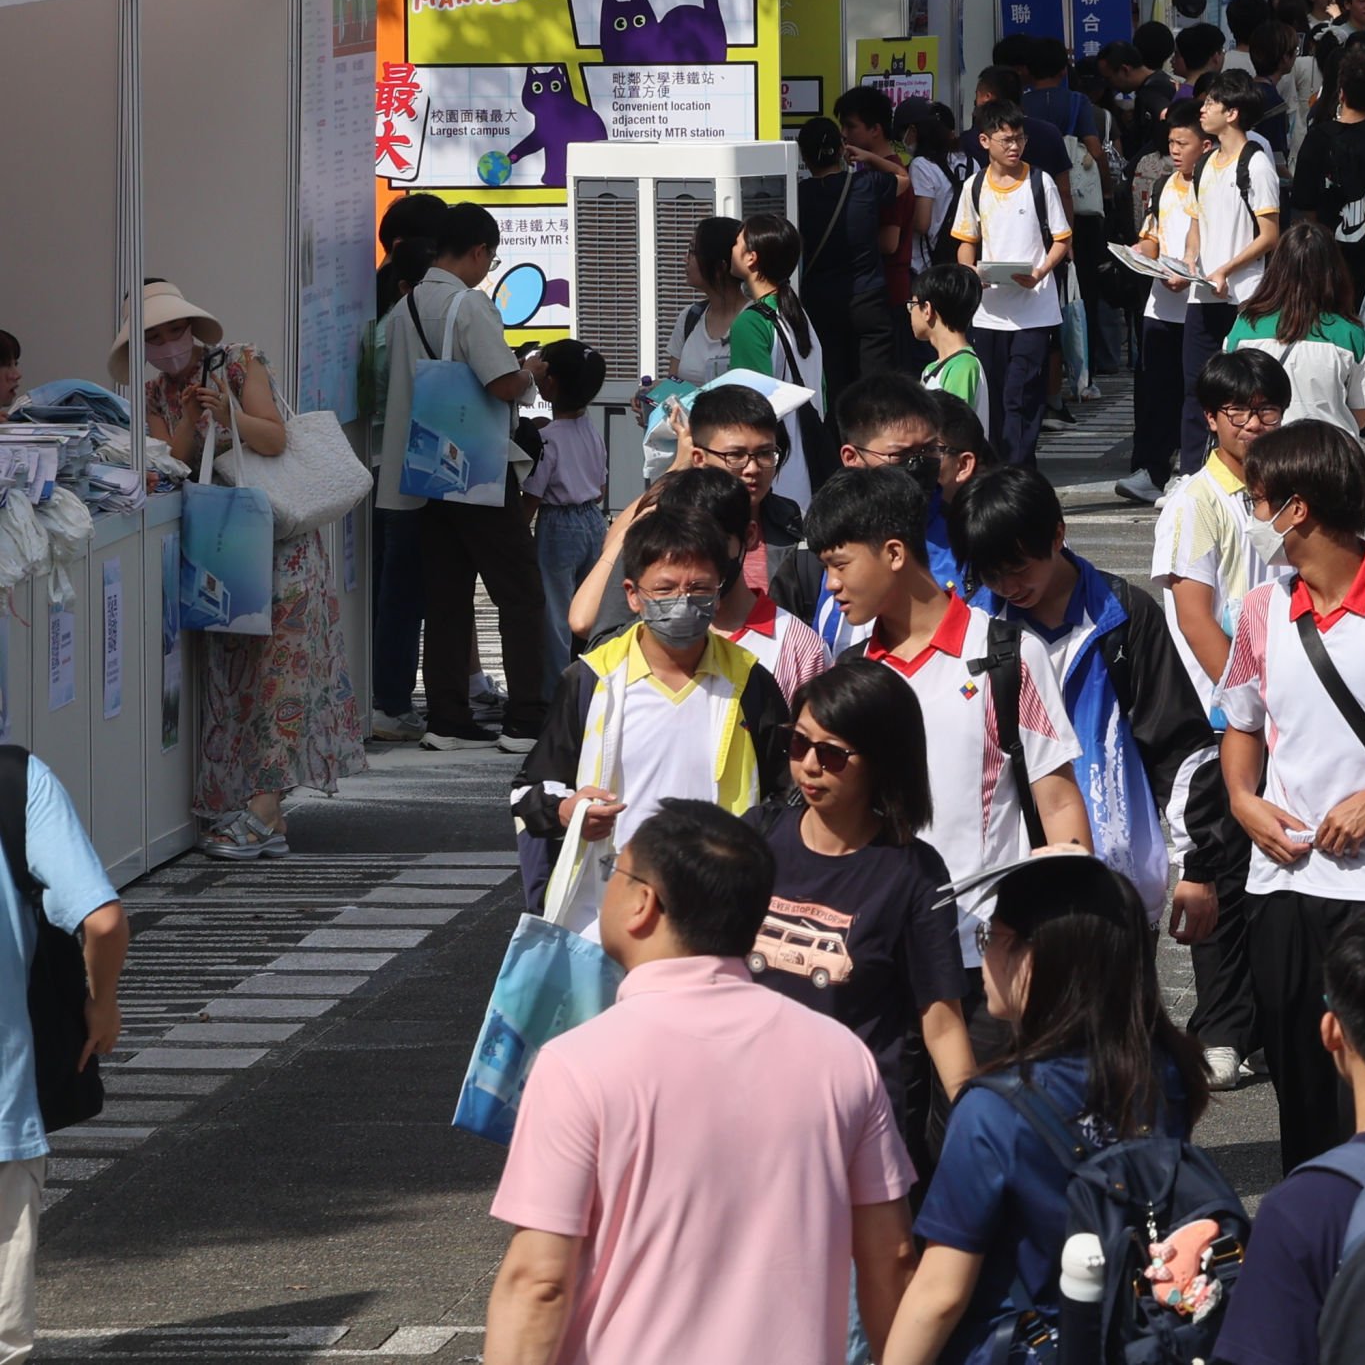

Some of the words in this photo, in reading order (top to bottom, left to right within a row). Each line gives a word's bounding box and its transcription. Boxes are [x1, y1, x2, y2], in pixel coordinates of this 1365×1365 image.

[1011, 4, 1031, 24] 聯
[612, 85, 671, 99] 位置方便
[612, 101, 667, 112] Convenient
[671, 101, 711, 111] location
[376, 61, 421, 172] 最大
[431, 109, 519, 124] 校園面積最大
[612, 115, 655, 127] adjacent
[659, 115, 668, 125] to
[430, 126, 468, 139] Largest
[471, 126, 511, 138] campus
[612, 129, 662, 140] University
[665, 128, 687, 138] MTR
[690, 127, 725, 138] station
[498, 219, 568, 233] 達港鐵大學
[500, 235, 537, 247] iversity
[540, 235, 562, 245] MTR
[771, 900, 790, 912] EVER
[791, 905, 810, 913] STOP
